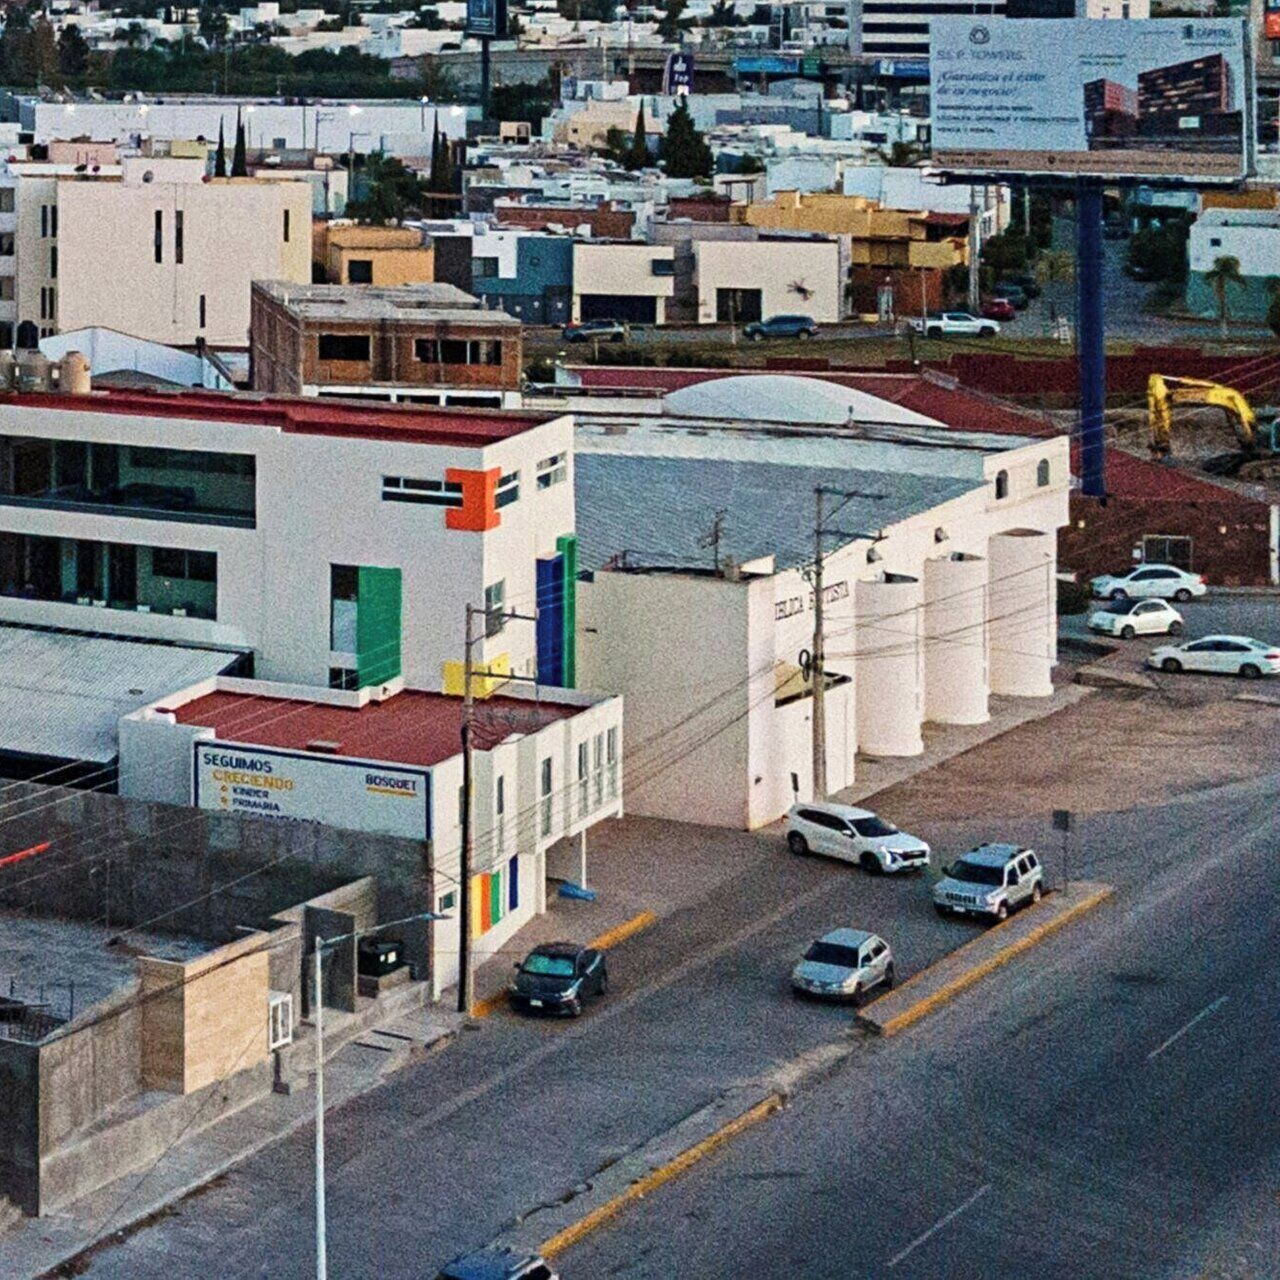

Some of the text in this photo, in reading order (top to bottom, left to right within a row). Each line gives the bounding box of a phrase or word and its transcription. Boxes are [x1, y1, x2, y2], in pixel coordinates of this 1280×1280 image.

[203, 753, 273, 773] SEGUIMOS
[212, 770, 294, 791] CRECIENDO
[365, 774, 417, 792] BOSQUET
[232, 786, 269, 799] KINDER
[232, 797, 280, 812] PRIMARIA
